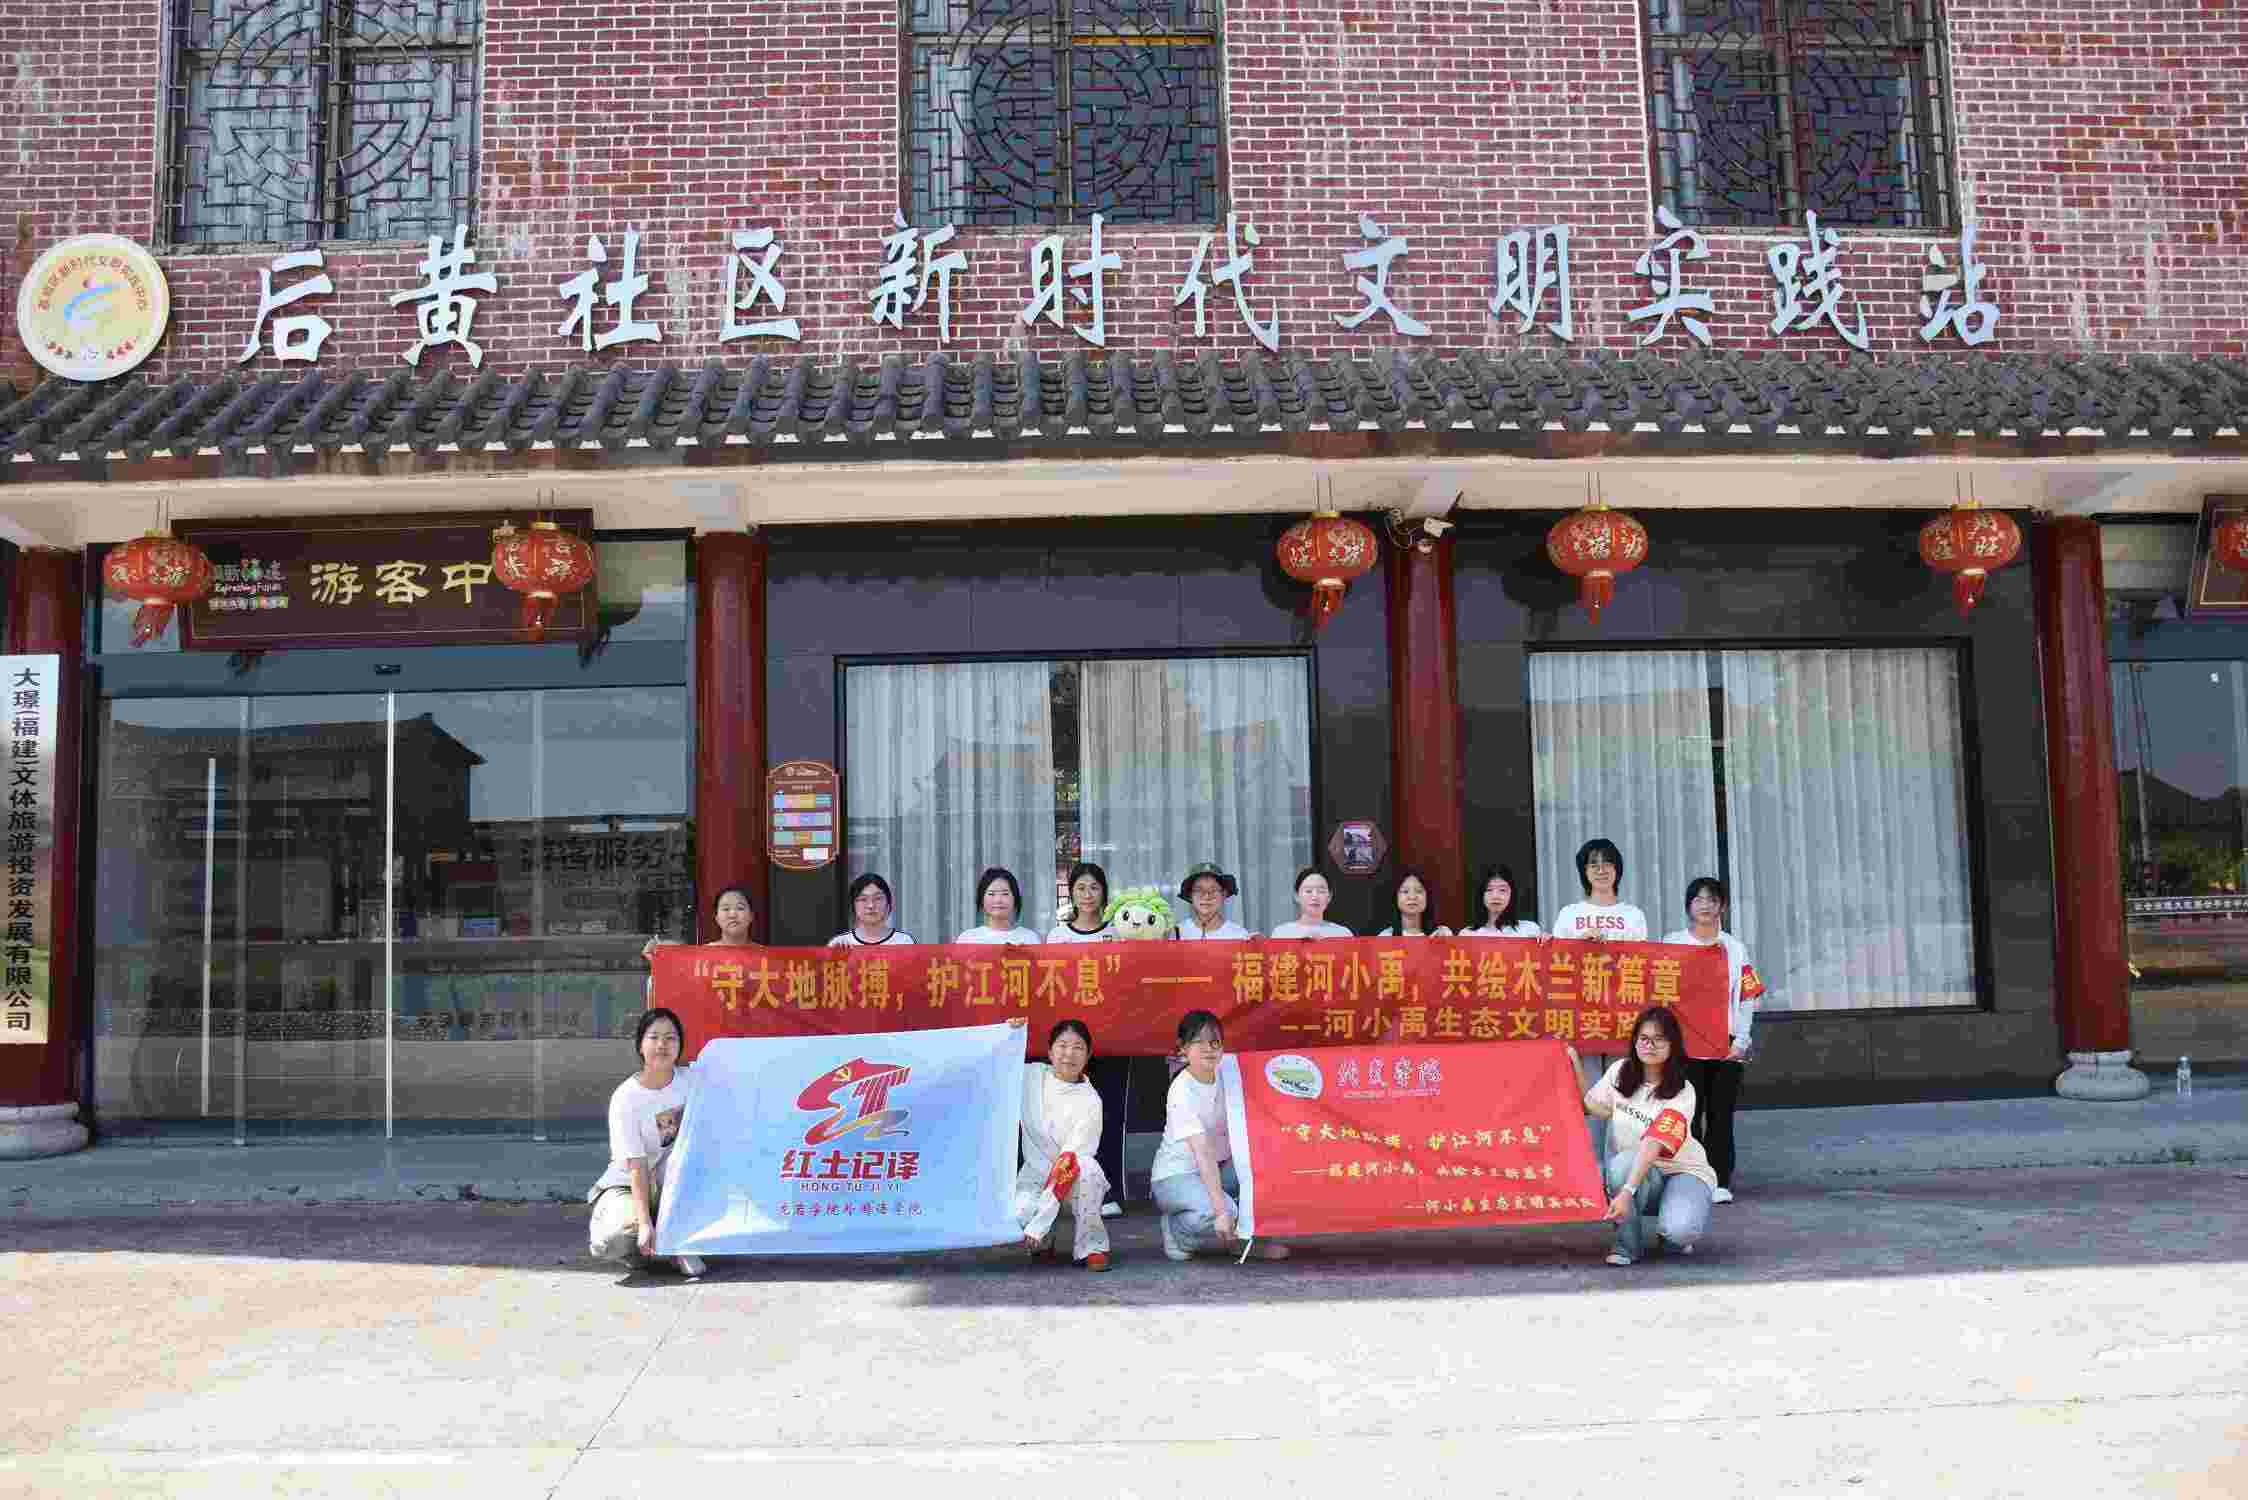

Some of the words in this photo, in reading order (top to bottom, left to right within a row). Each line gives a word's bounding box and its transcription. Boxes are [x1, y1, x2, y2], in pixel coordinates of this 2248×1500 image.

[240, 205, 2000, 368] 后黄社区新时代文明实践站
[310, 557, 494, 606] 游客中
[1575, 916, 1625, 931] BLESS
[780, 1149, 920, 1180] 红土记译
[801, 1182, 840, 1192] HONG
[847, 1182, 864, 1192] TU
[888, 1182, 900, 1192] YI
